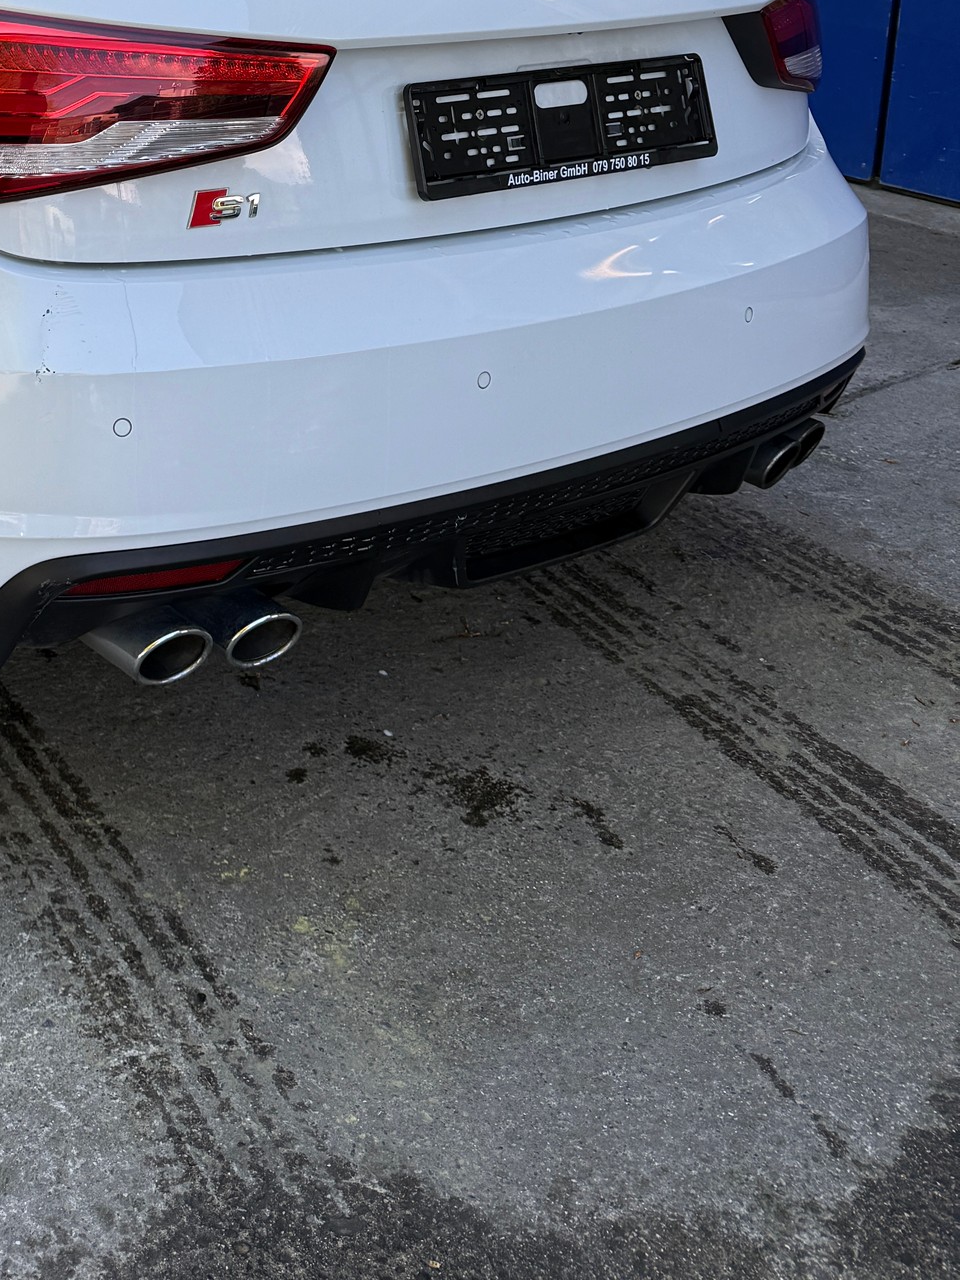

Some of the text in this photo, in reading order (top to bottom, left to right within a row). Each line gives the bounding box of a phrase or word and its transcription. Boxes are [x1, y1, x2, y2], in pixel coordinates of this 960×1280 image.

[507, 153, 650, 186] Auto-Biner GmbH 079 750 80 15
[209, 195, 260, 221] S1
